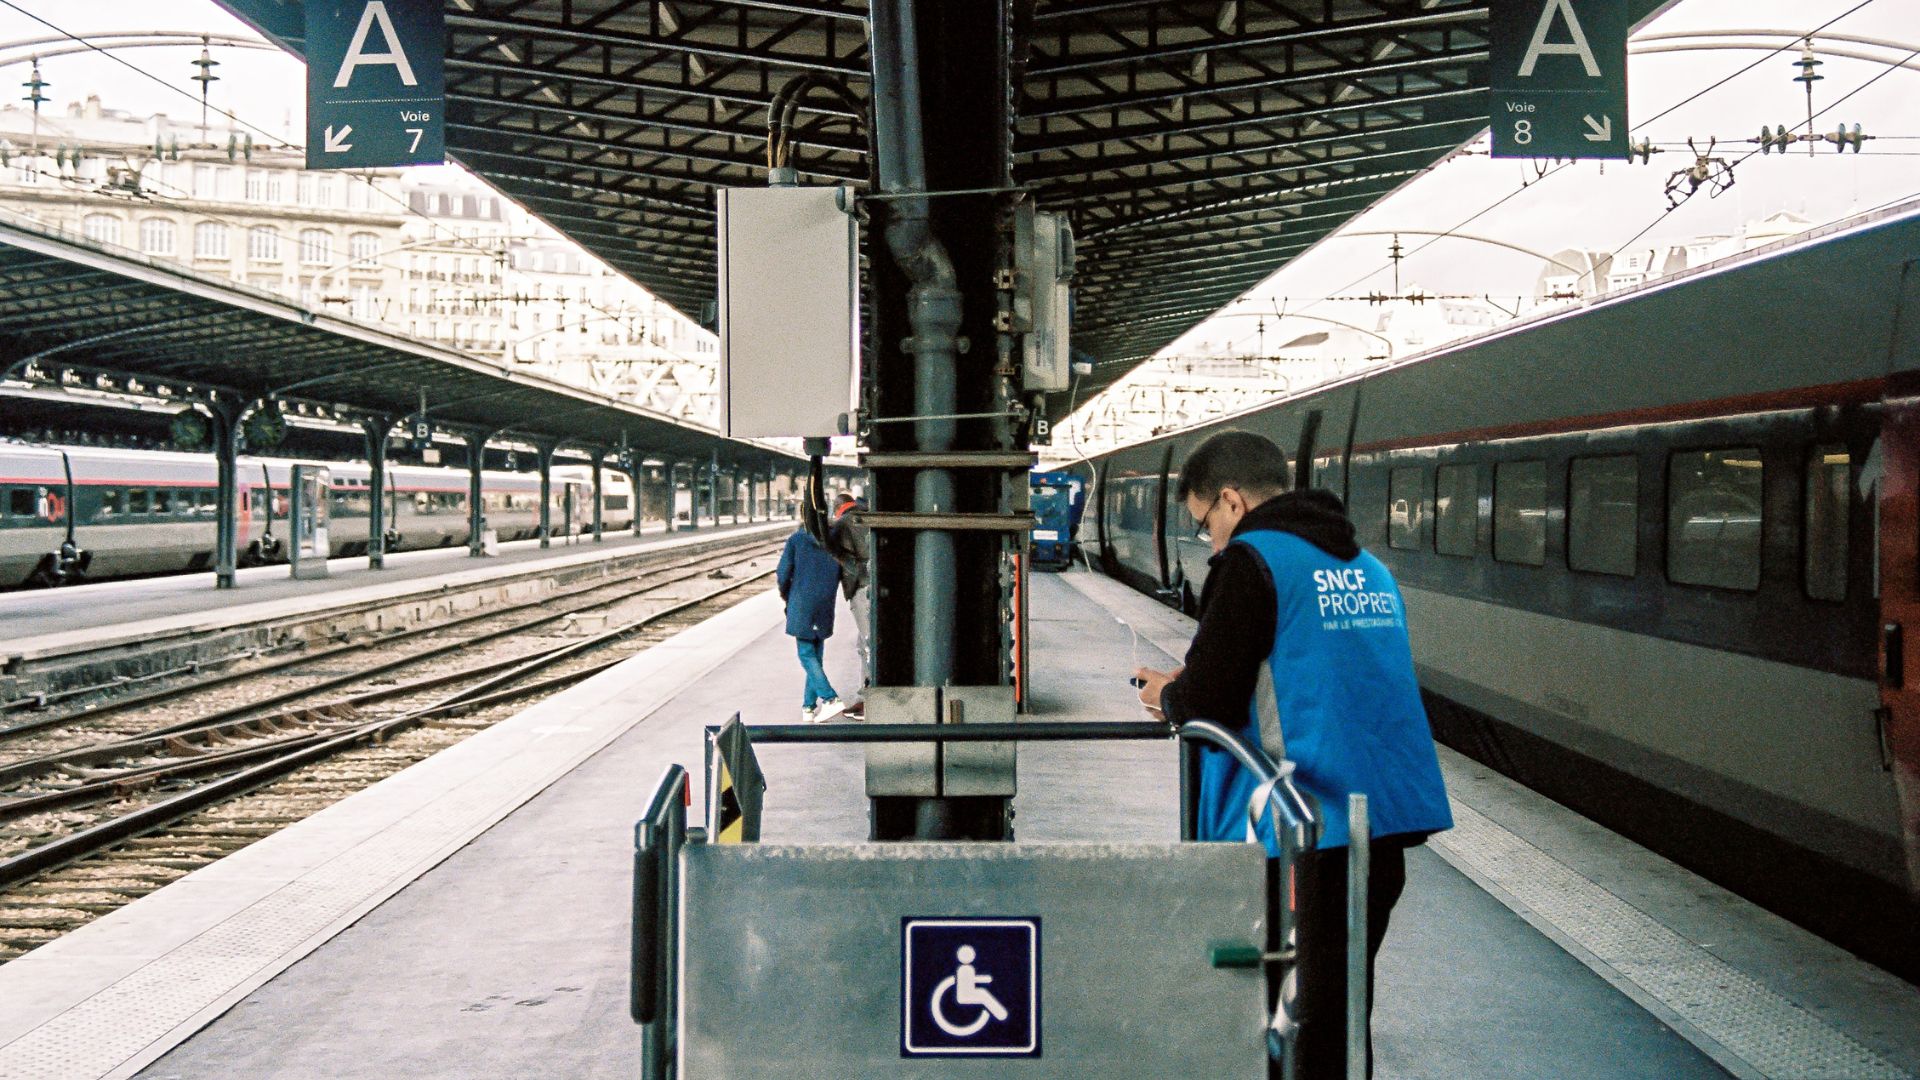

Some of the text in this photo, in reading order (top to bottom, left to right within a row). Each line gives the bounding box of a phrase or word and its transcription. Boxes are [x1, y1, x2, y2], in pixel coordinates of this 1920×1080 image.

[333, 0, 418, 88] A
[1517, 0, 1602, 77] A
[400, 110, 430, 122] Voie
[1506, 102, 1536, 113] Voie
[405, 128, 423, 154] 7
[1514, 119, 1532, 144] 8
[417, 423, 428, 438] B
[1038, 420, 1048, 434] B
[1313, 569, 1366, 592] SNCF
